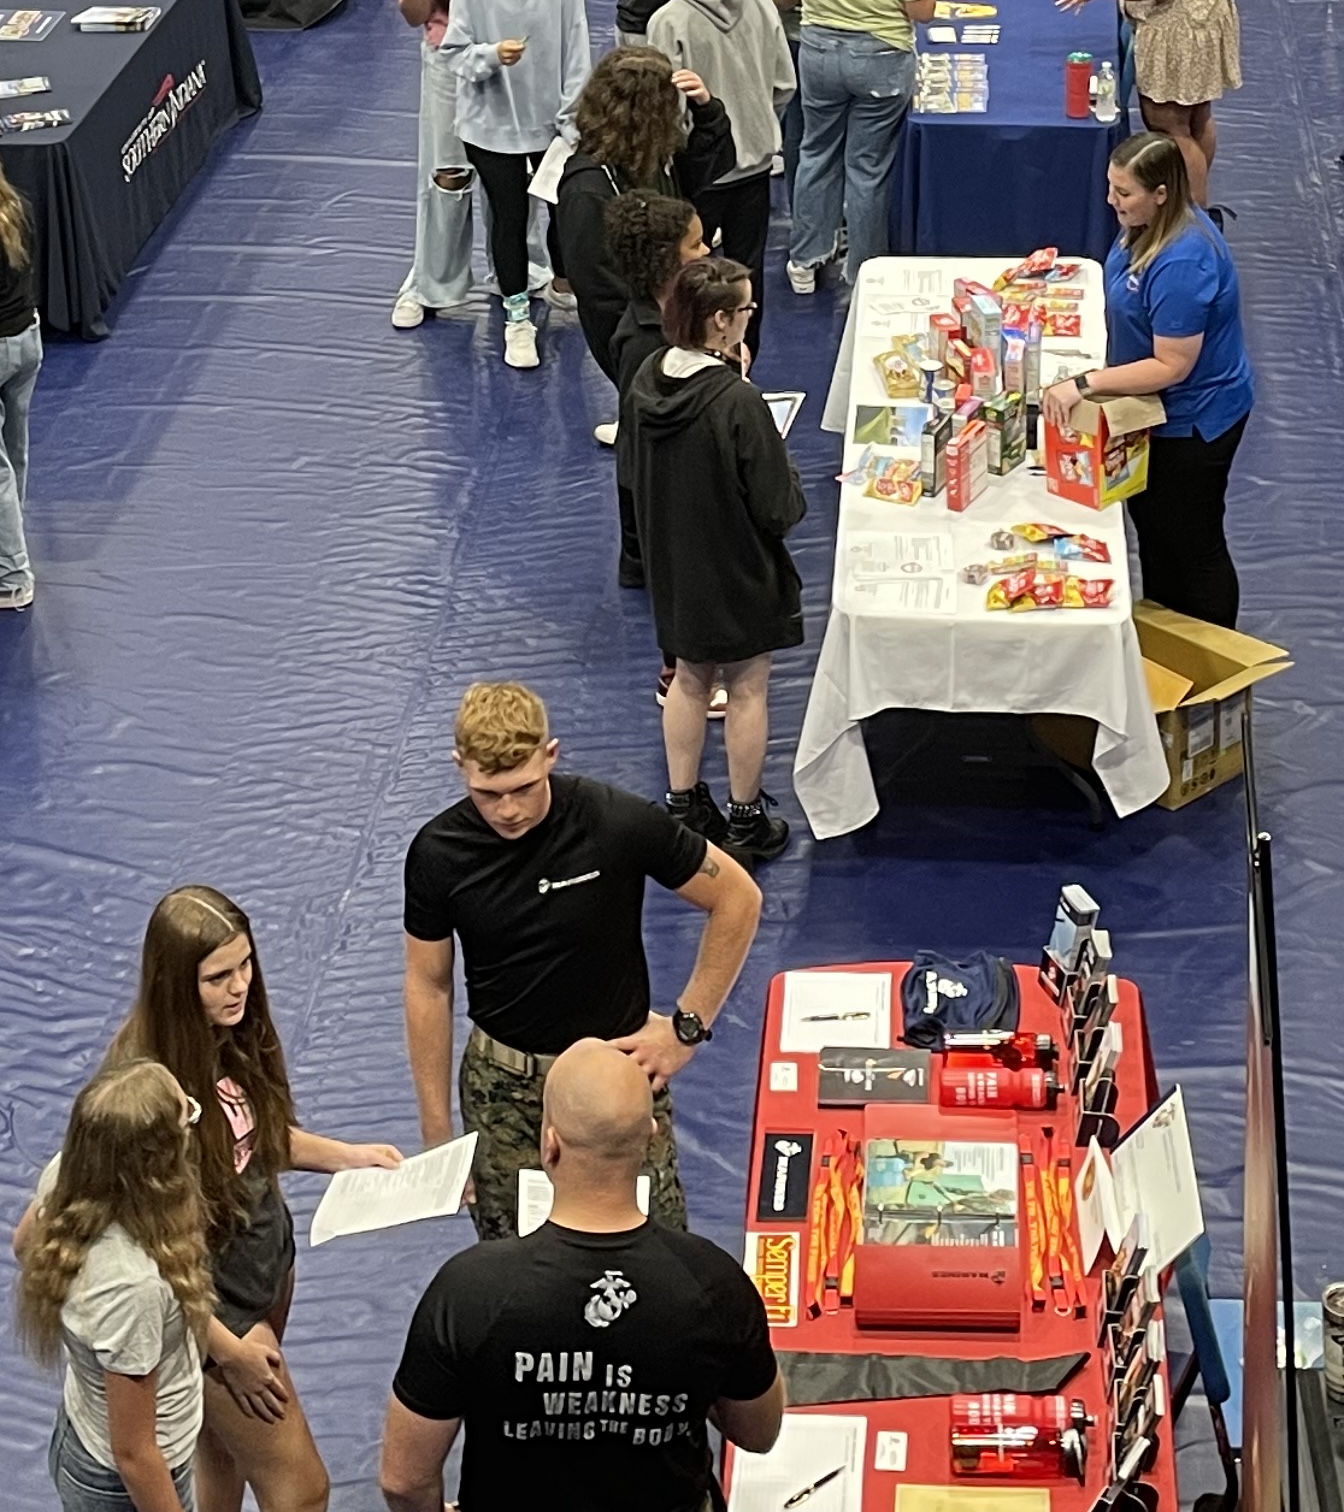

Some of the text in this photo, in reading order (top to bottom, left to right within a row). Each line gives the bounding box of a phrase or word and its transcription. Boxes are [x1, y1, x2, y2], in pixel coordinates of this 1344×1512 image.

[764, 1235, 797, 1304] Semper
[514, 1351, 633, 1388] PAIN IS
[543, 1390, 689, 1417] WEAKNESS
[503, 1420, 596, 1441] LEAVING
[599, 1419, 629, 1434] THE
